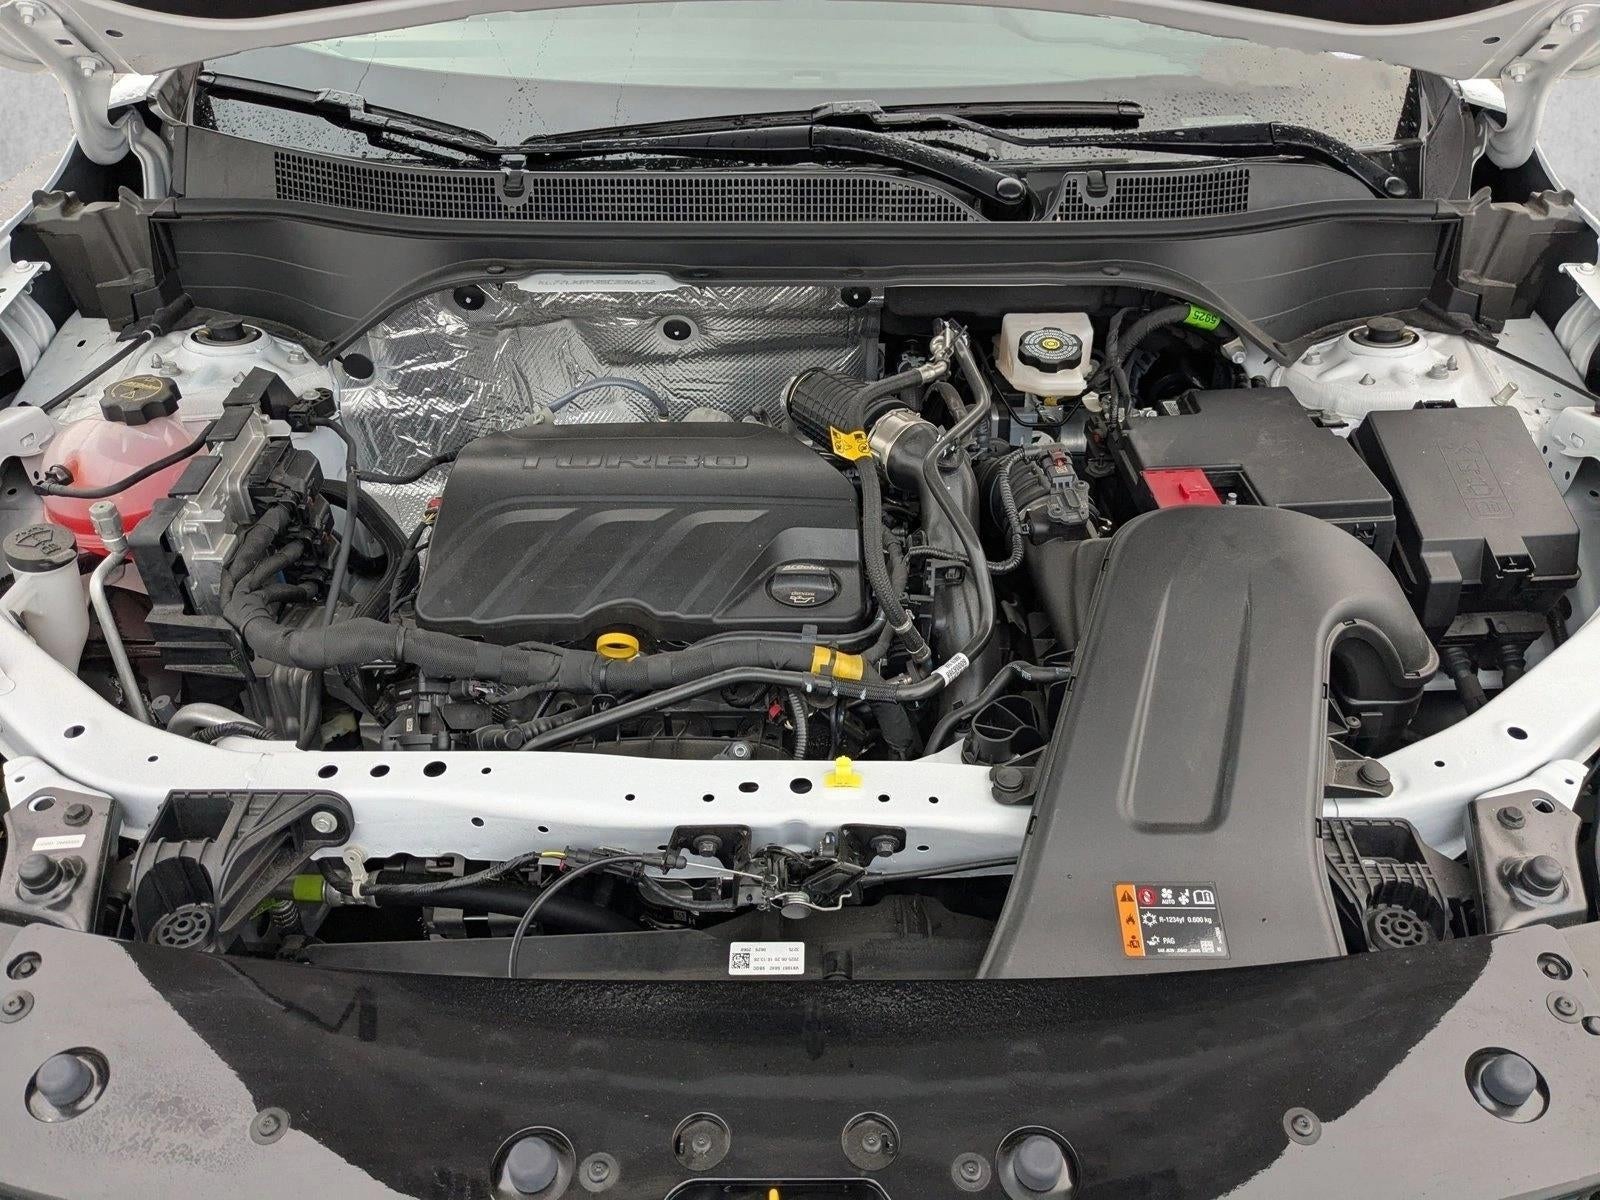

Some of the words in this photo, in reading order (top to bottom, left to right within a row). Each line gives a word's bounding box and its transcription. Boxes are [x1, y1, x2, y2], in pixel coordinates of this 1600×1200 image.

[1192, 310, 1217, 324] 5925
[511, 454, 750, 470] TURBO
[1158, 916, 1185, 924] R-1234yf
[1204, 916, 1213, 924] kg
[1162, 937, 1176, 945] PAG
